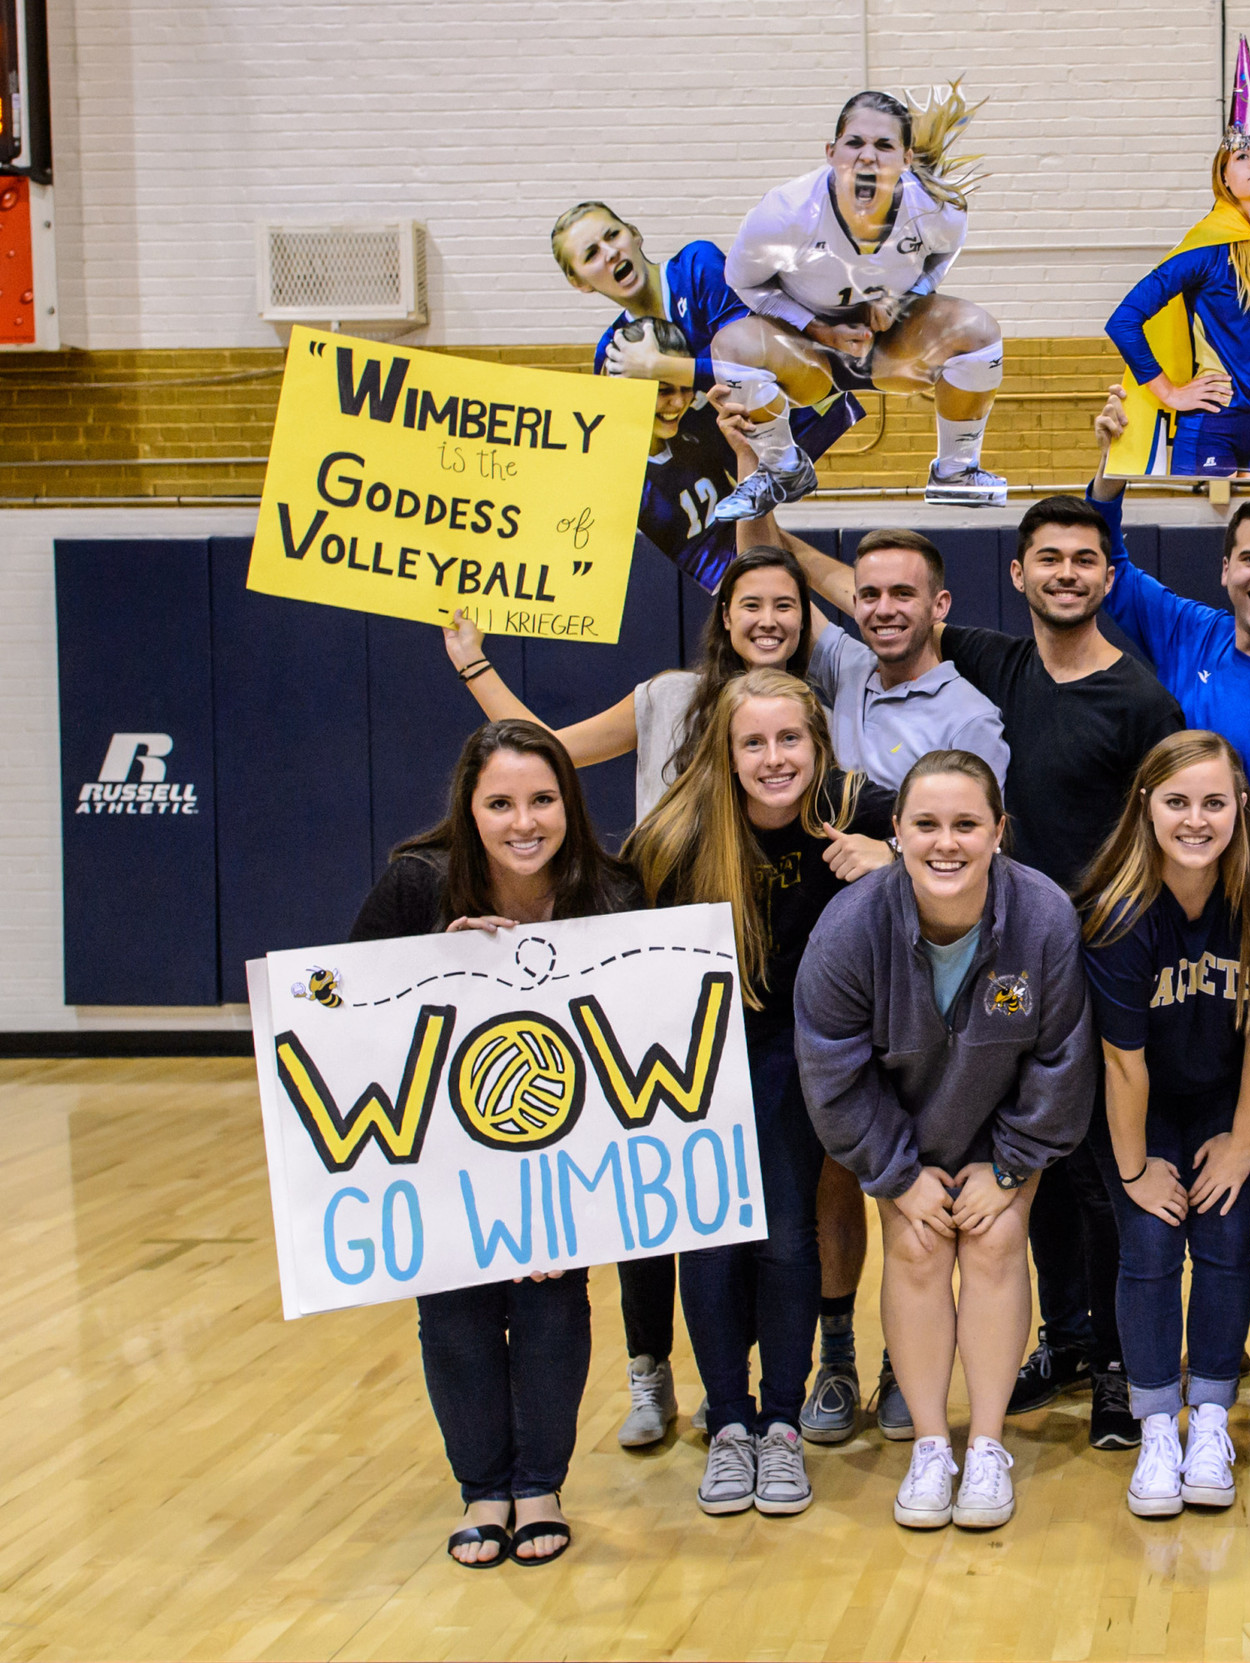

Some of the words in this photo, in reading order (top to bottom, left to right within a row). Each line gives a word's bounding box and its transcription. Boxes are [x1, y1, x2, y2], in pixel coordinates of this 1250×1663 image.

[438, 441, 466, 473] is
[477, 449, 518, 482] the
[316, 451, 522, 539] GODDESS
[556, 507, 595, 550] of
[679, 476, 718, 540] 12
[505, 610, 599, 637] KRIEGER
[75, 802, 196, 815] ATHLETIC
[78, 783, 198, 802] RUSSELL
[275, 971, 734, 1174] WOW
[324, 1179, 424, 1285] GO
[459, 1123, 753, 1270] WIMBO!
